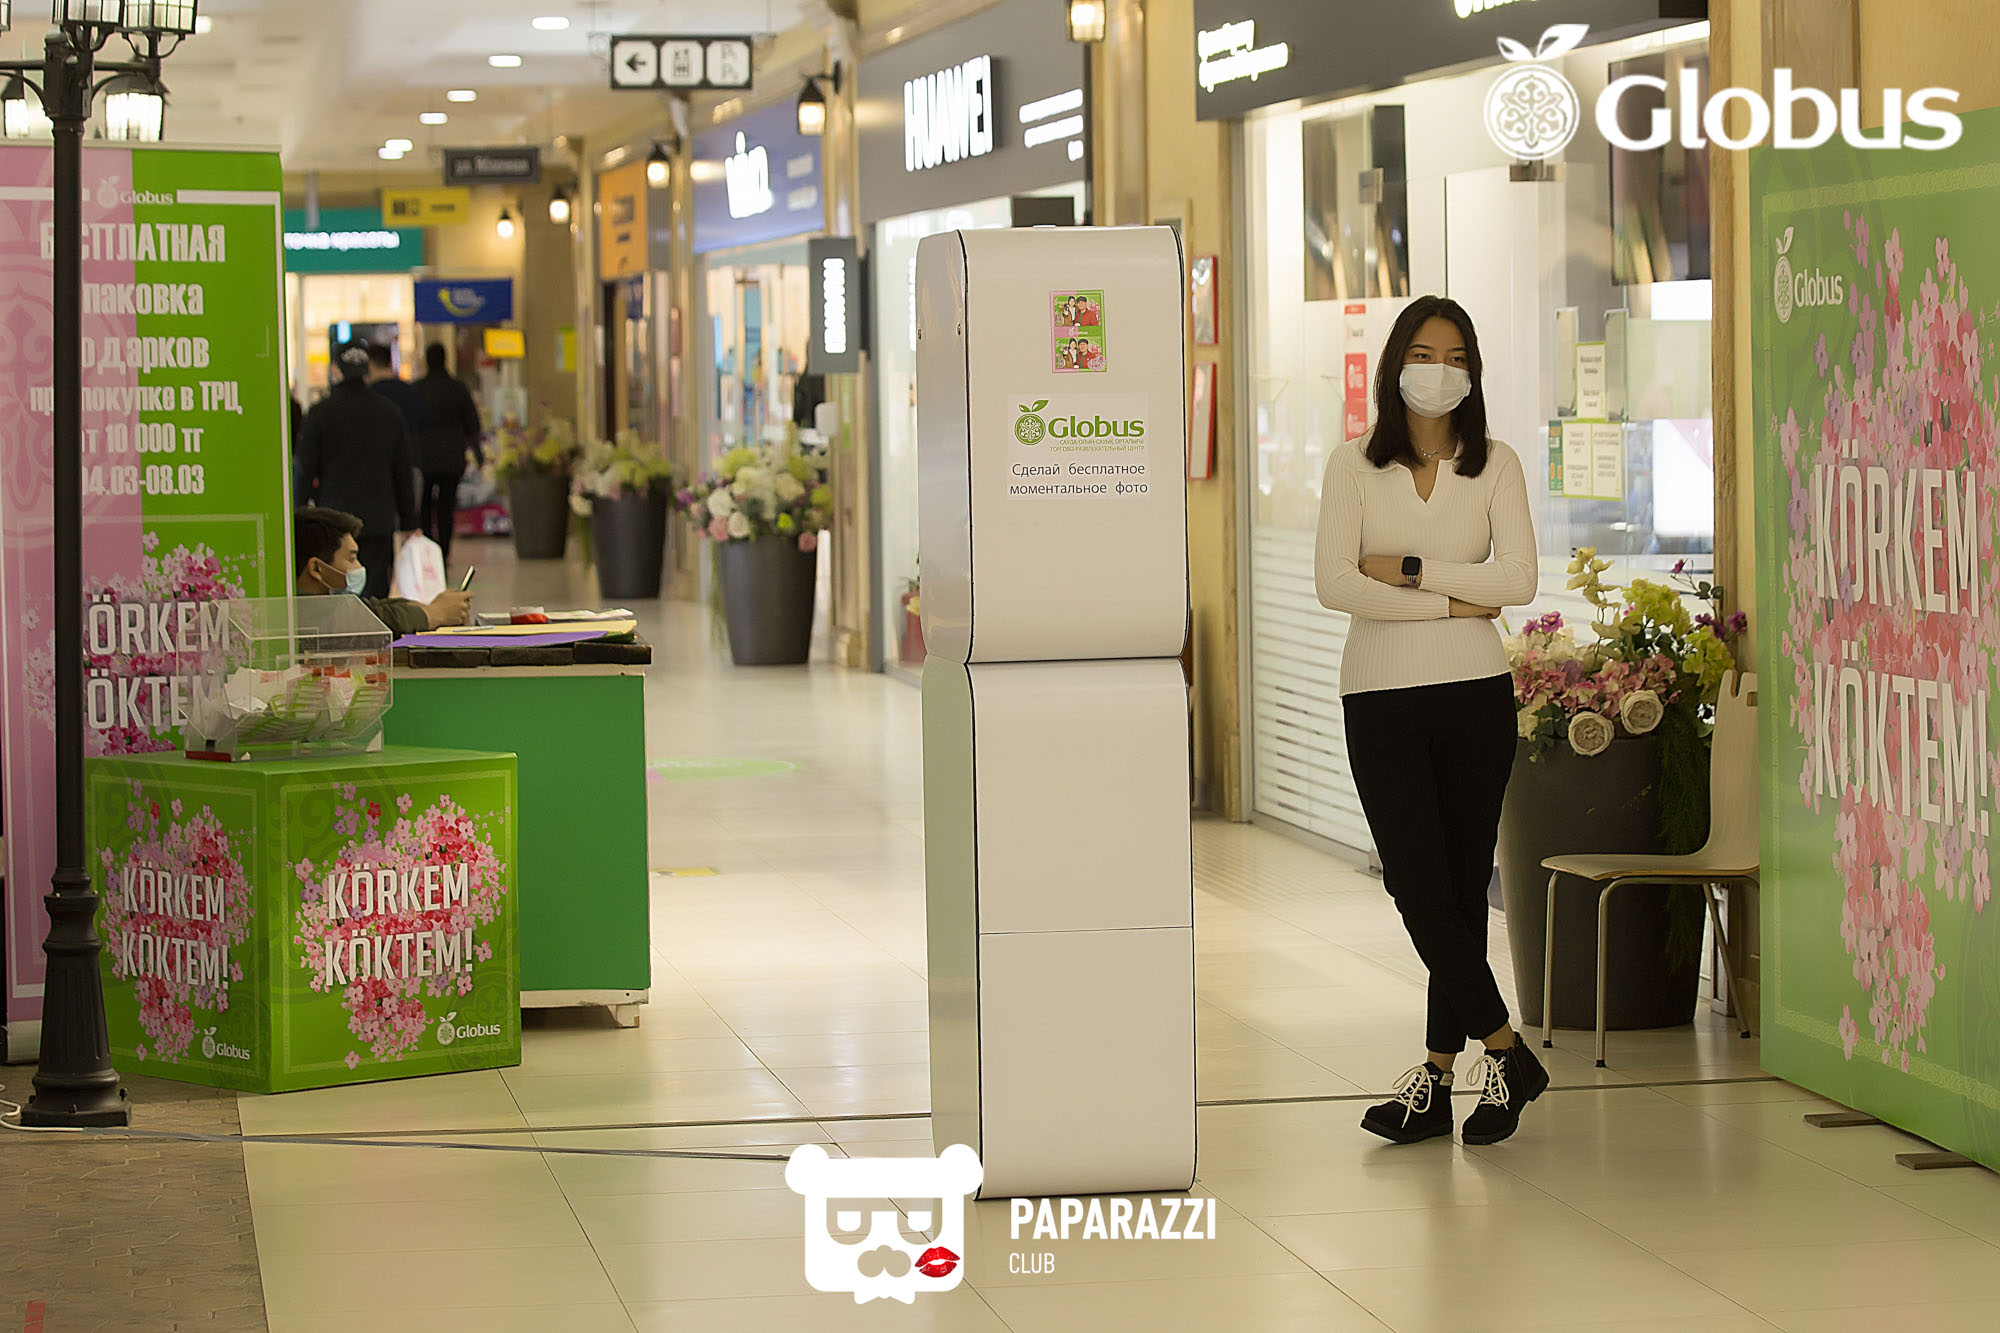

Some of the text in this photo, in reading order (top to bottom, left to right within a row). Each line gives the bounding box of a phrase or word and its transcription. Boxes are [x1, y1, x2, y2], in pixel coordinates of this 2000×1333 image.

[904, 54, 993, 172] HUAWEI
[120, 189, 174, 205] Globus
[40, 222, 226, 262] БСПЛАТНАЯ
[81, 282, 204, 315] паковка
[1794, 267, 1843, 307] Globus
[81, 336, 210, 374] одарков
[181, 386, 194, 411] в
[199, 381, 243, 414] ТРЦ
[105, 423, 128, 453] 10
[134, 422, 176, 453] 000
[181, 428, 204, 453] тг
[1048, 415, 1145, 438] Globus
[1010, 481, 1148, 495] моментальное фото
[1012, 462, 1145, 477] Сделай бесплатное
[1815, 438, 1980, 618] KÖRKEM
[84, 594, 230, 656] ÖRKEM
[1815, 639, 1990, 837] KÖKTEM!
[123, 861, 225, 923] KÖRKEM
[328, 862, 469, 919] KÖRKEM
[121, 925, 229, 991] KÖKTEM!
[325, 927, 474, 986] KÖKTEM!
[455, 1022, 501, 1039] Globus
[216, 1042, 251, 1061] Globus
